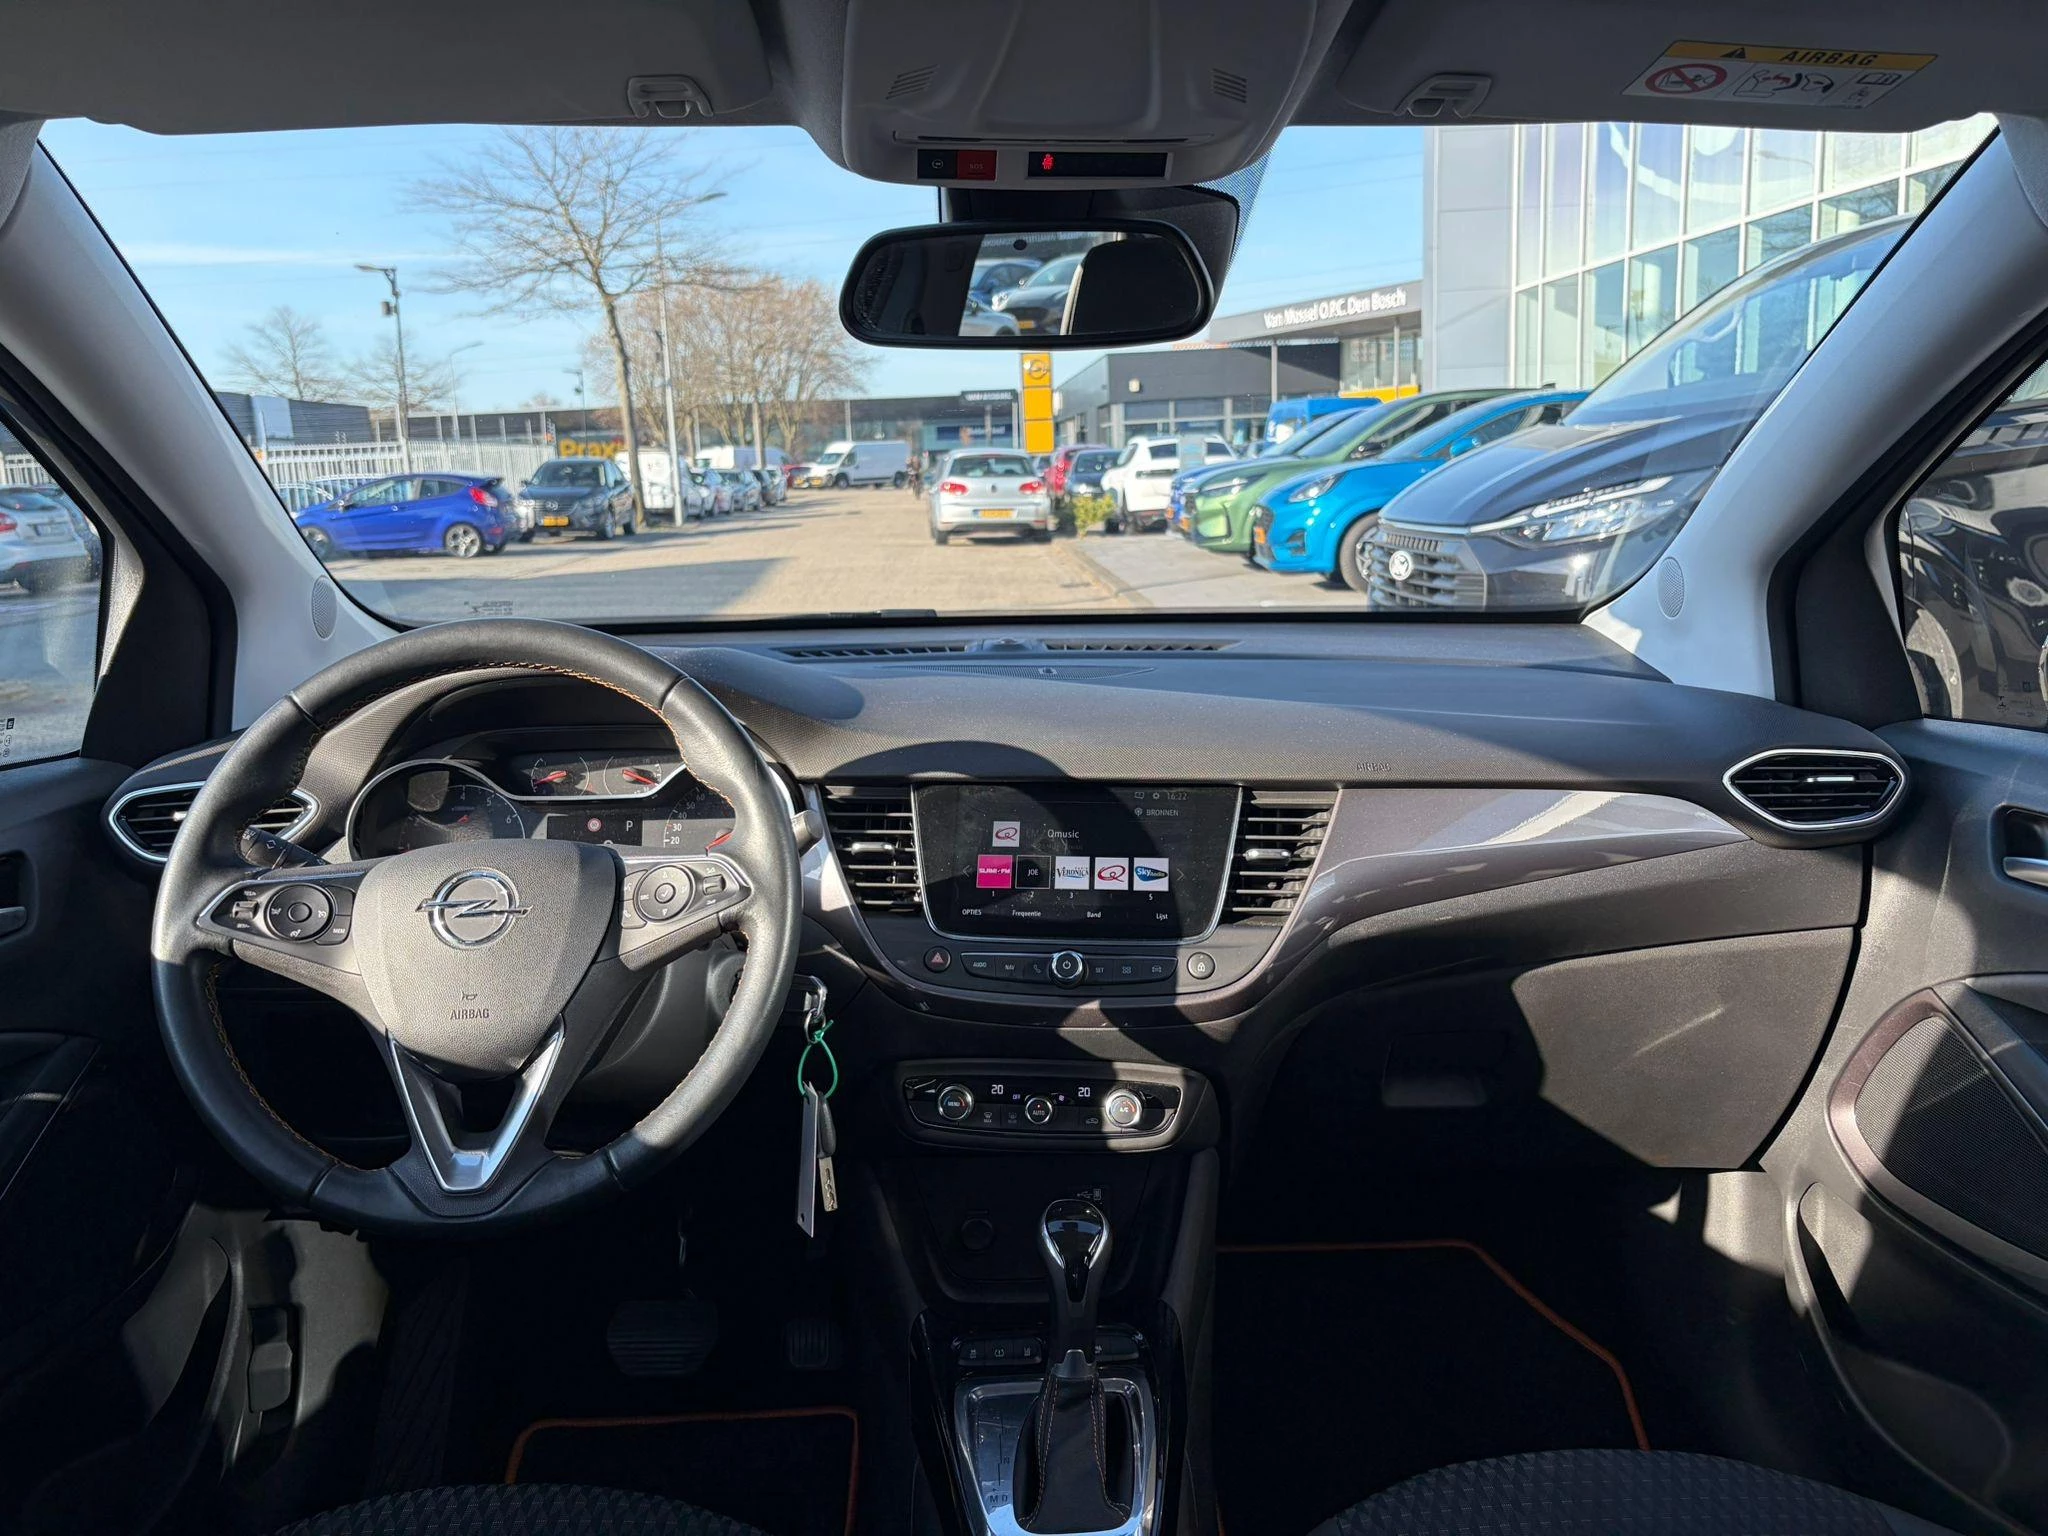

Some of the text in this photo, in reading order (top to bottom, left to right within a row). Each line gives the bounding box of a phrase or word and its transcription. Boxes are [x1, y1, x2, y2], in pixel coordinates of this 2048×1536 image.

[1780, 50, 1879, 67] AIRBAG
[1371, 286, 1407, 311] Bosch
[1146, 809, 1179, 817] BRONNEN
[626, 821, 634, 832] P
[672, 823, 683, 832] 30
[1047, 829, 1080, 839] Qmusic
[670, 836, 680, 845] 20
[1027, 868, 1039, 876] JOE
[1136, 866, 1151, 877] Sky
[1012, 910, 1042, 918] Frequentie
[1156, 912, 1168, 920] Lijst
[450, 1008, 490, 1020] AIRBAG
[991, 1084, 1004, 1095] 20
[1078, 1086, 1091, 1097] 20
